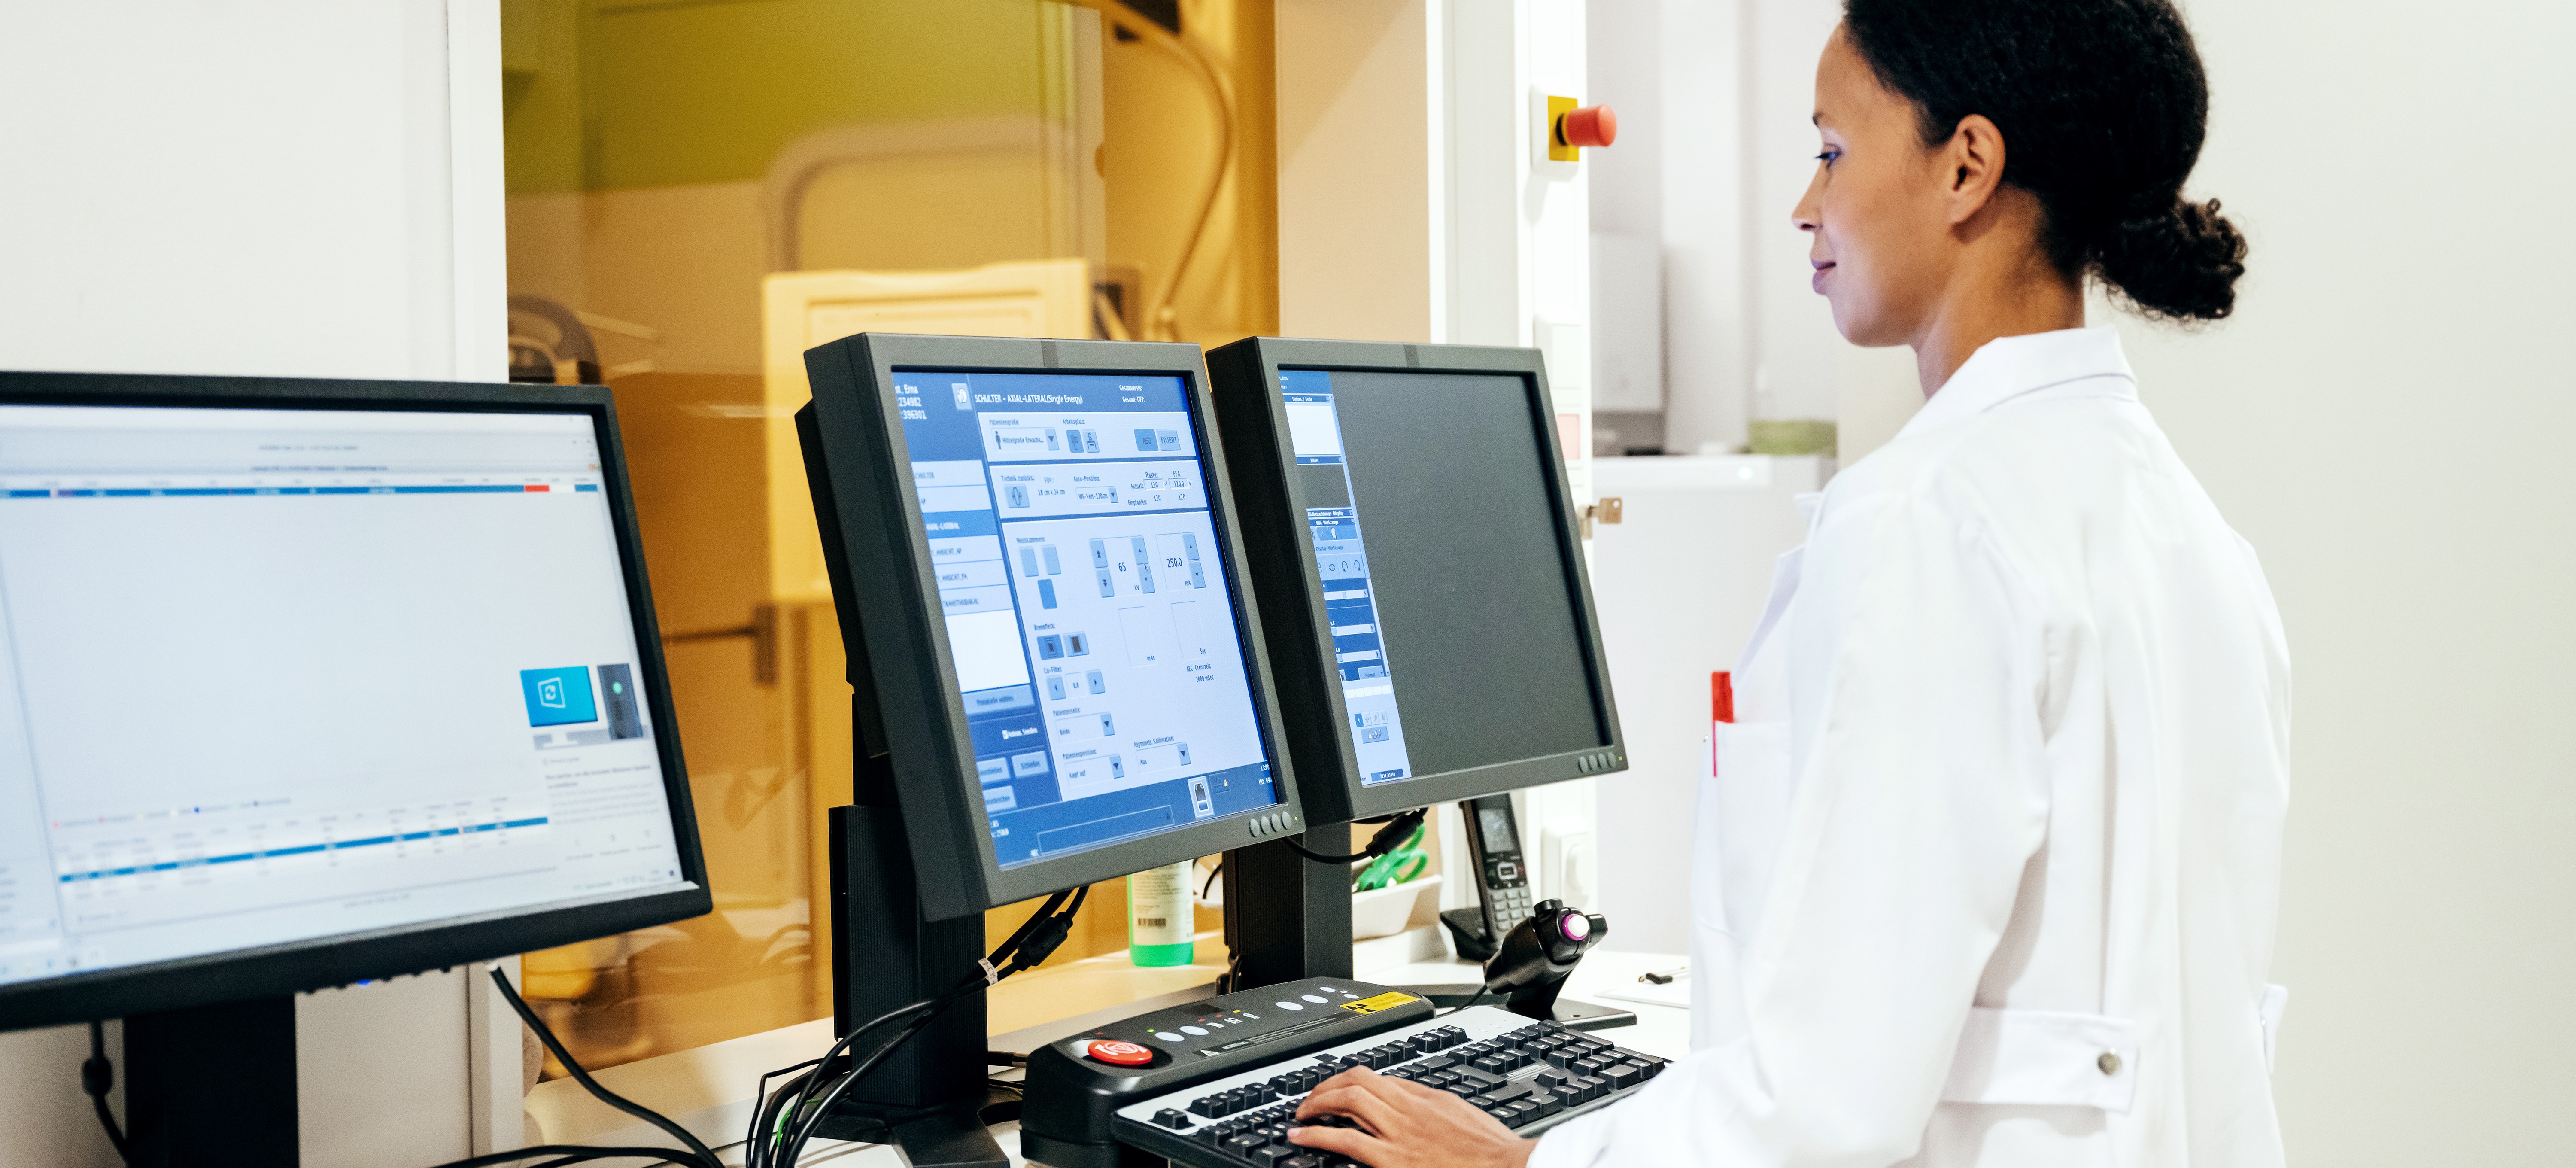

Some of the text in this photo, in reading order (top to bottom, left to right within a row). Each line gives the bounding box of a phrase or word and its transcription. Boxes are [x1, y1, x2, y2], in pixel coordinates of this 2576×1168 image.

[974, 394, 1002, 403] SCHULTER
[1063, 395, 1083, 405] Energy)
[1118, 562, 1127, 572] 65
[1166, 557, 1183, 568] 250.0
